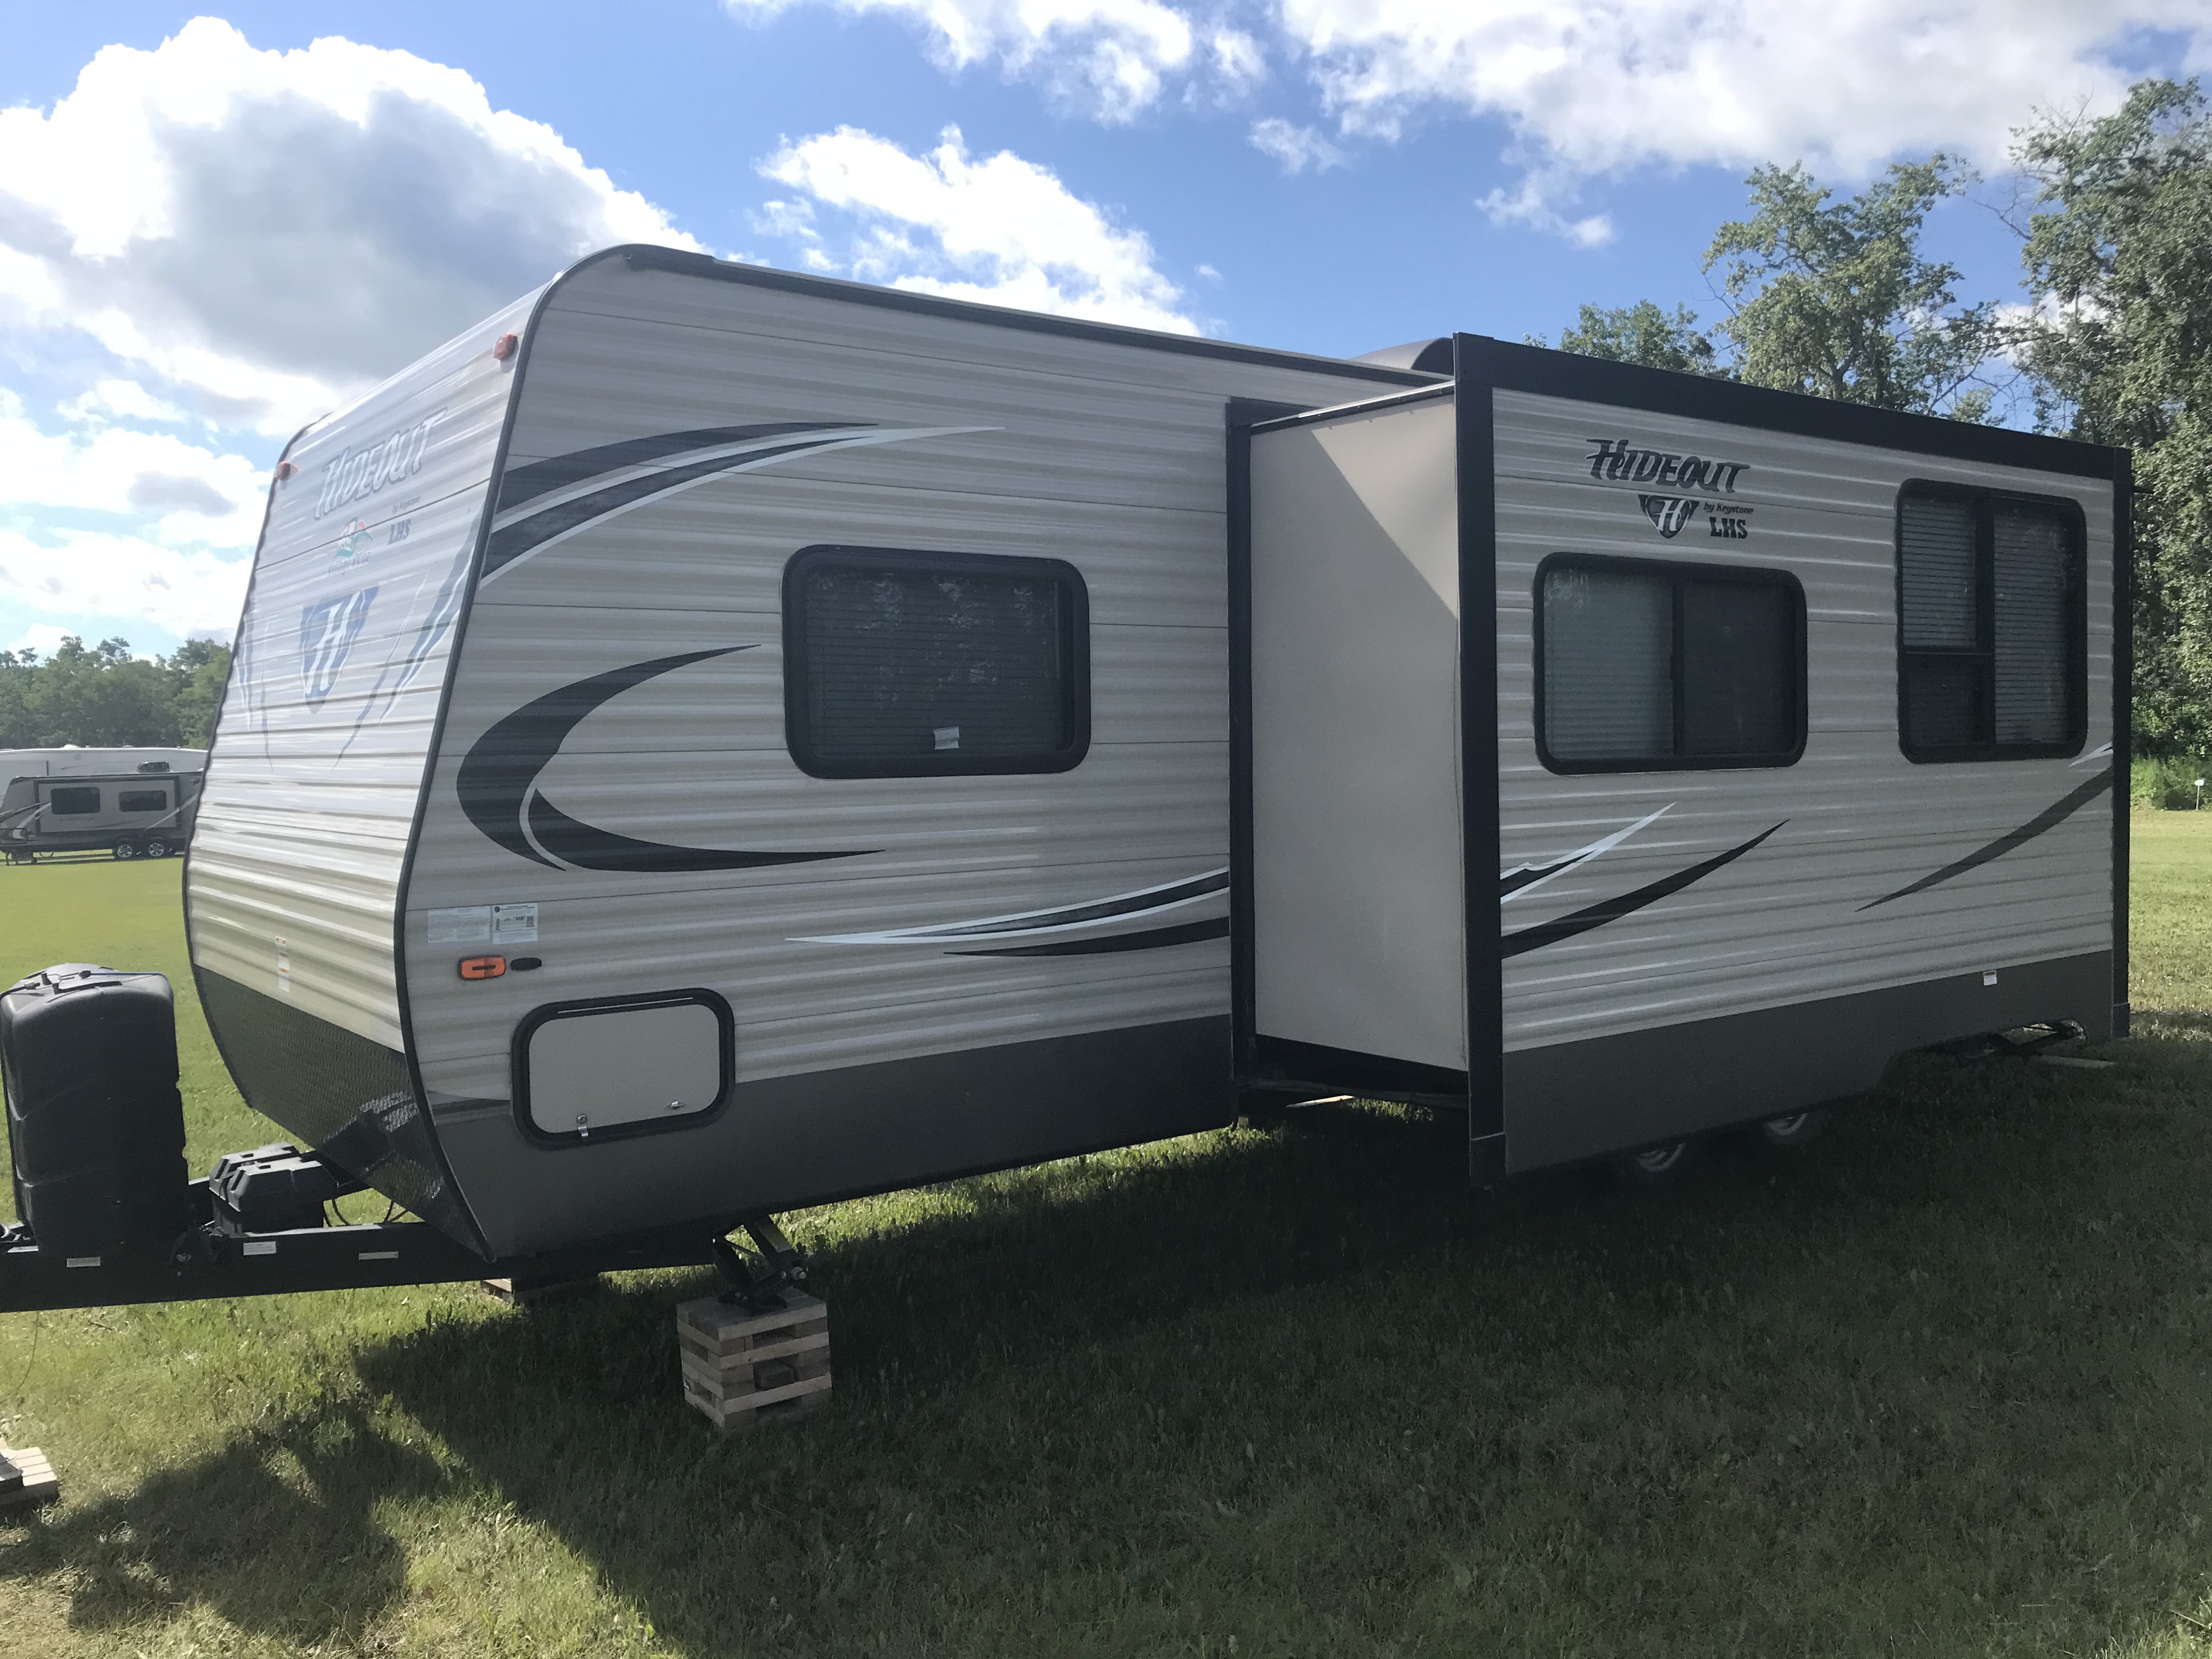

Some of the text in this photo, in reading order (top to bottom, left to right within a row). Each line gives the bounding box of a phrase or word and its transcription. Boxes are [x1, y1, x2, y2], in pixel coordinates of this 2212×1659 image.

[314, 406, 447, 520] HIDEOUT
[1586, 439, 1750, 493] HIDEOUT
[1704, 502, 1754, 514] by Keystone
[387, 518, 411, 545] LHS
[1709, 517, 1747, 539] LHS
